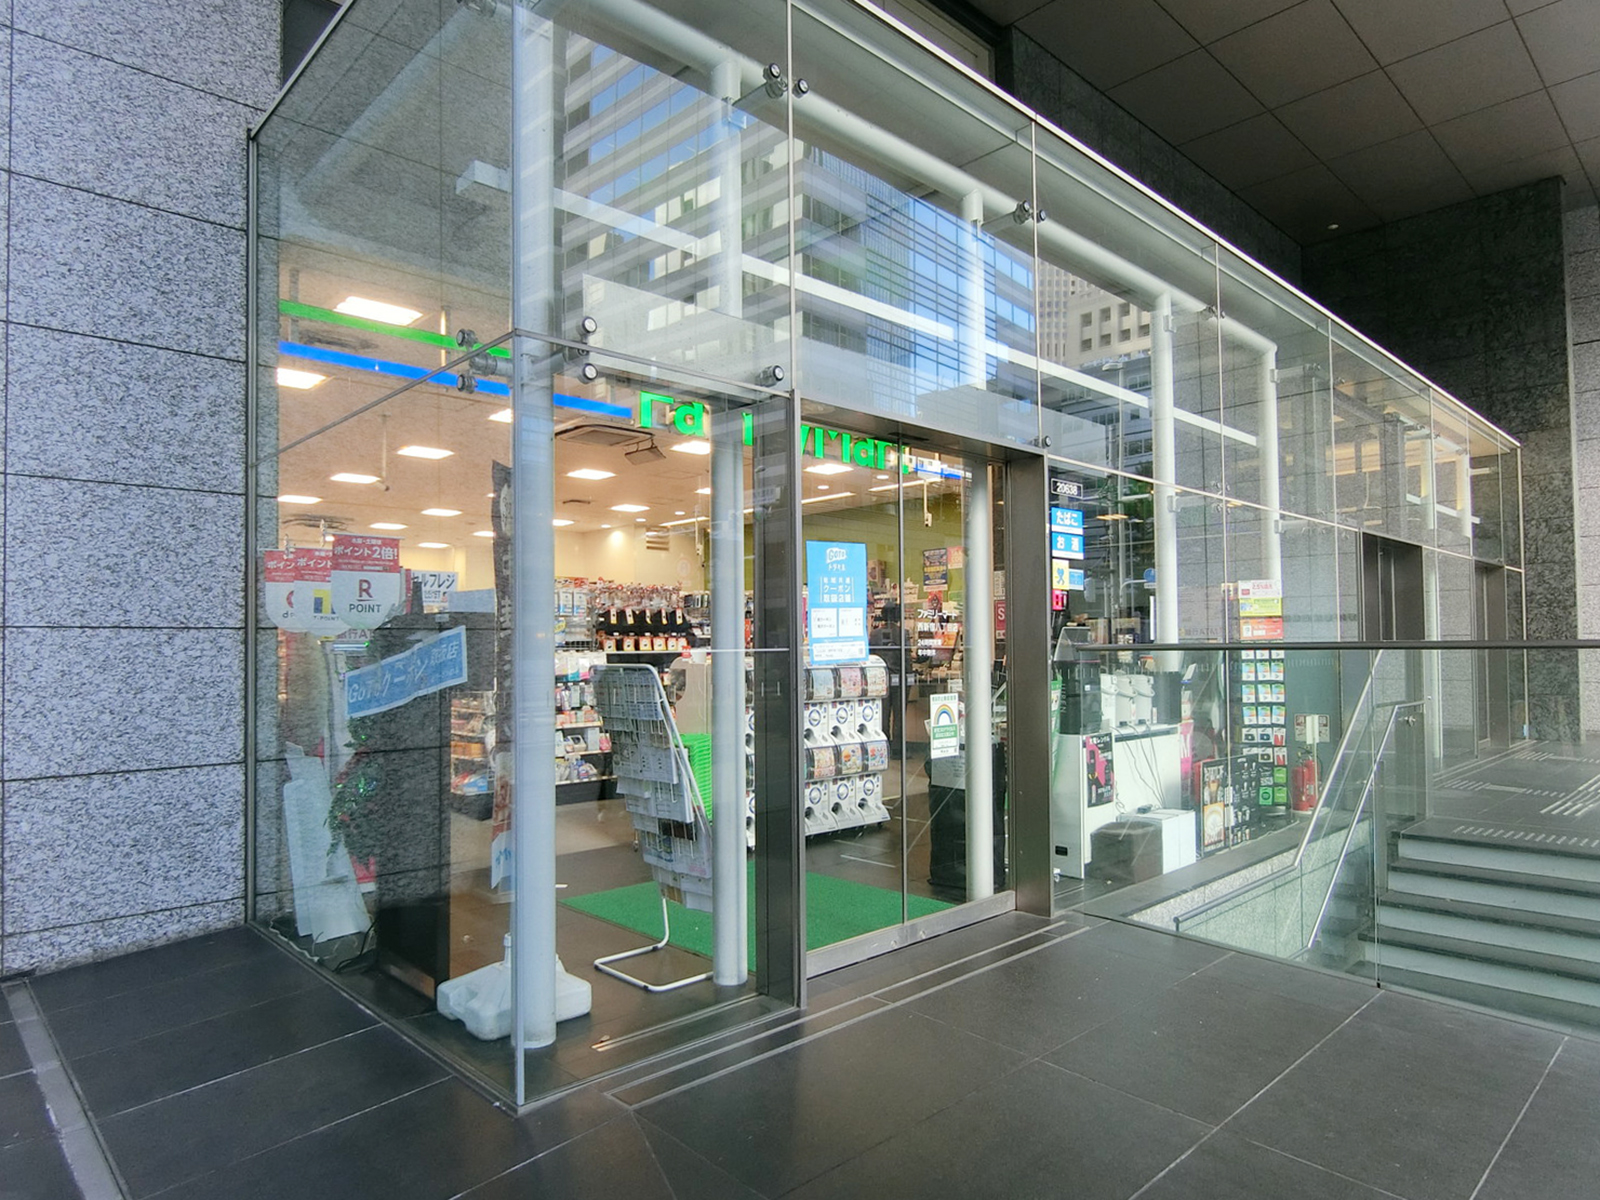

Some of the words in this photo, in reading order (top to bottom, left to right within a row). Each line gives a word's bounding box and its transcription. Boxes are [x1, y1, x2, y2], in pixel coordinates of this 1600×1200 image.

[1056, 482, 1078, 496] 20638
[1056, 510, 1079, 526] たばこ
[359, 579, 374, 598] R
[349, 603, 382, 613] POINT
[917, 609, 958, 620] ファミリーマート
